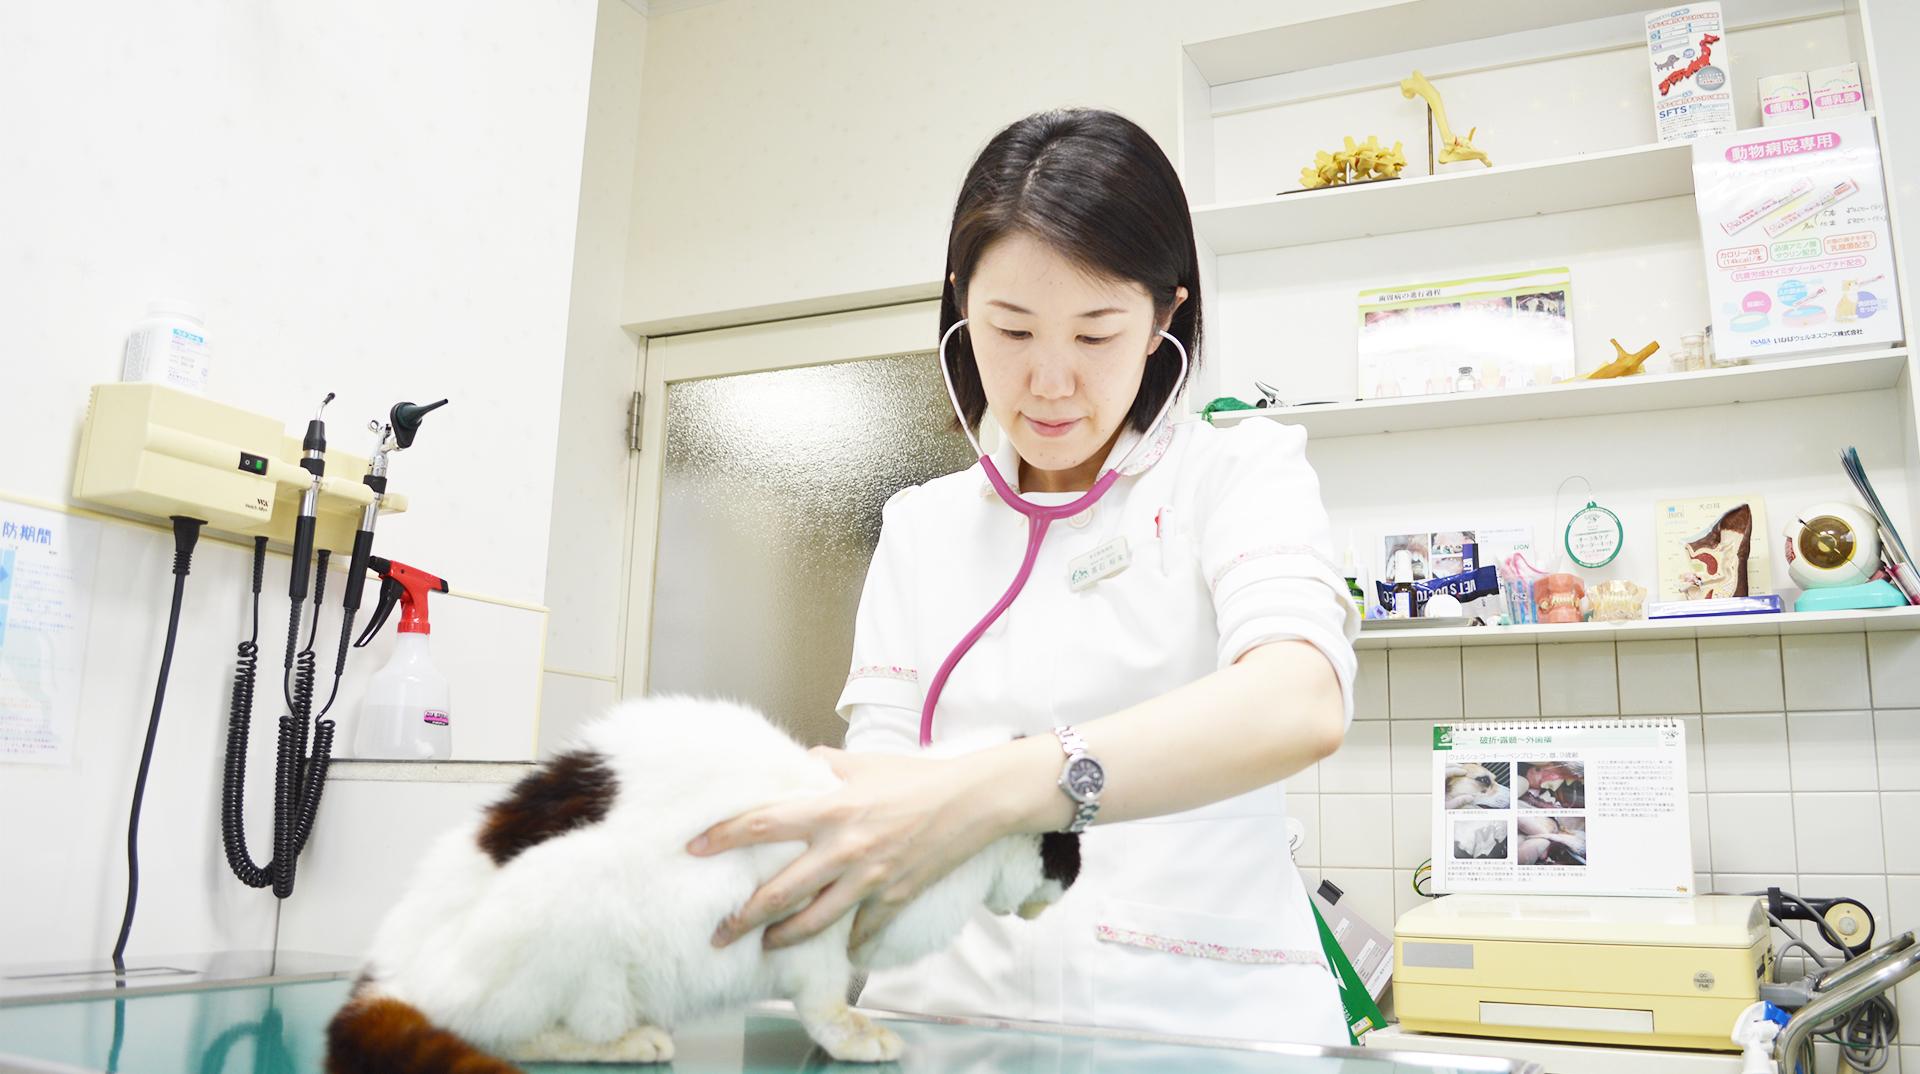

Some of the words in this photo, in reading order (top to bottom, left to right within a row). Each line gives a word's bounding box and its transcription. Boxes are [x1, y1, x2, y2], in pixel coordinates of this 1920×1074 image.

[1820, 92, 1856, 106] 哺乳器
[1659, 105, 1687, 119] SFTS
[1769, 99, 1805, 114] 哺乳器
[1731, 133, 1834, 162] 動物病院専用
[1774, 240, 1817, 252] 必須アミノ酸
[1830, 240, 1870, 252] 乳酸菌配合
[1775, 248, 1818, 260] タウリン配合
[1379, 288, 1441, 302] 歯周病の進行過程
[1698, 502, 1721, 511] 犬の耳
[2, 521, 52, 546] 防期間
[1513, 543, 1530, 551] LION
[1416, 584, 1449, 603] DOCTO
